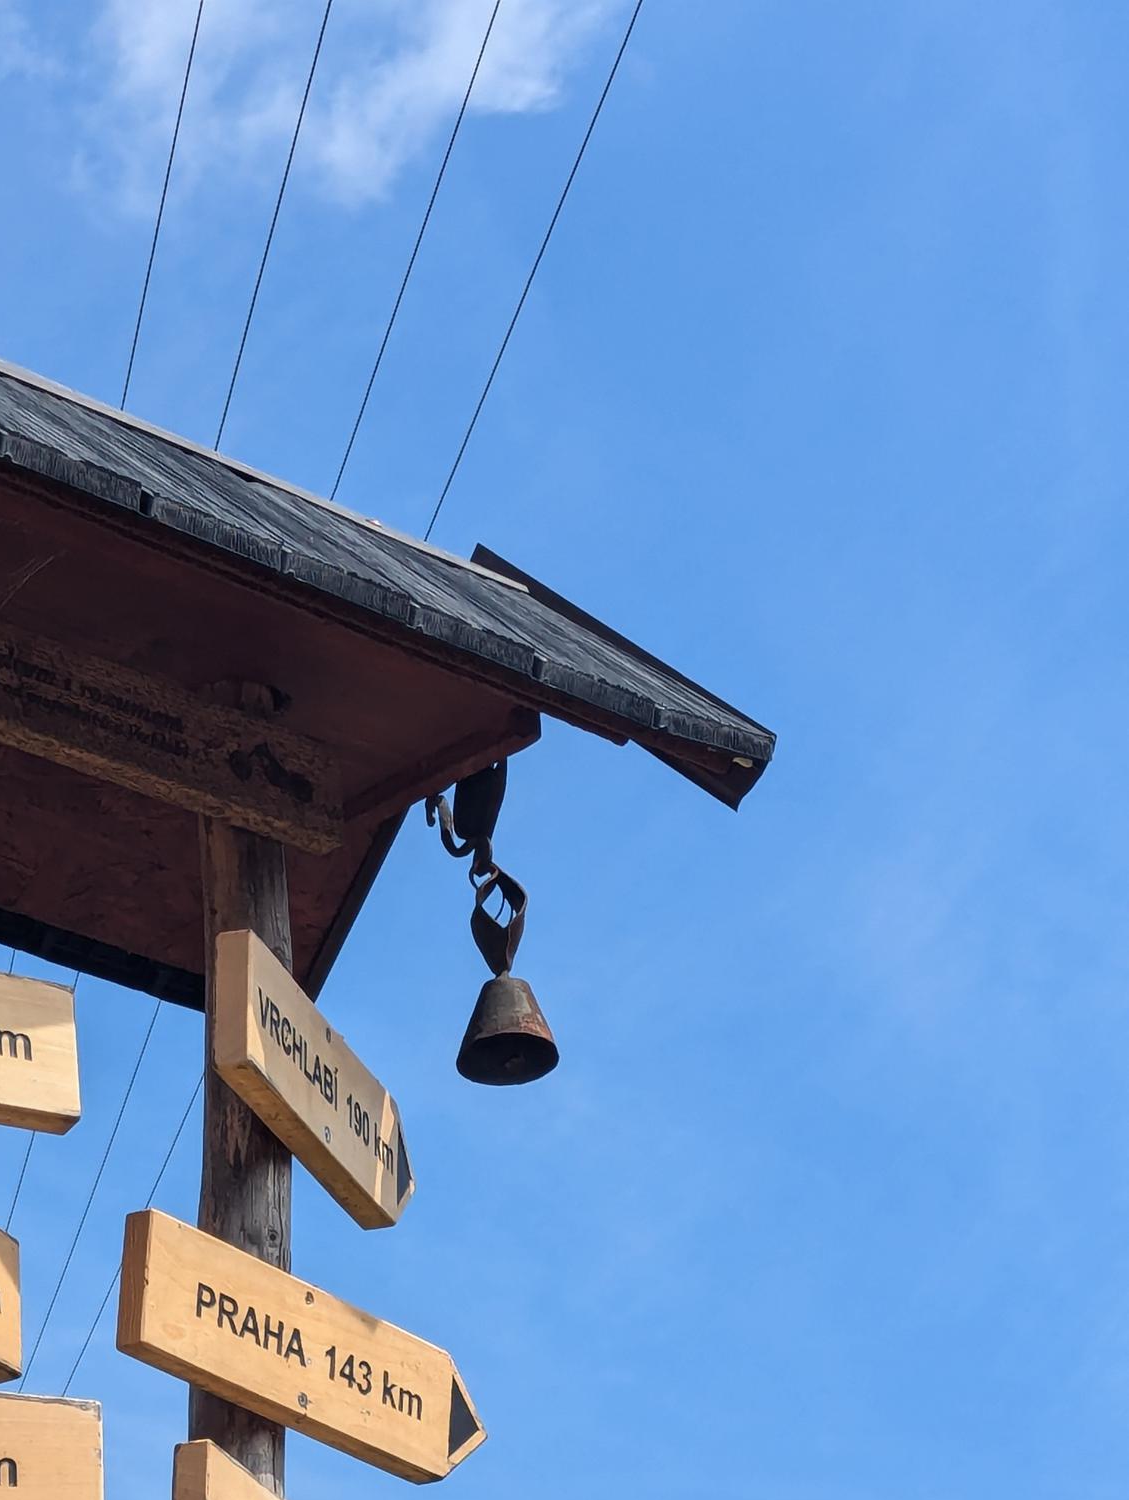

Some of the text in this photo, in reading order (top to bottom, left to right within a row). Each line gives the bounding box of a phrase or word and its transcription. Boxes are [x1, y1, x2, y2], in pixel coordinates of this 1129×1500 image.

[257, 987, 394, 1174] VRCHLABÍ 190 km
[196, 1283, 423, 1420] PRAHA 143 km
